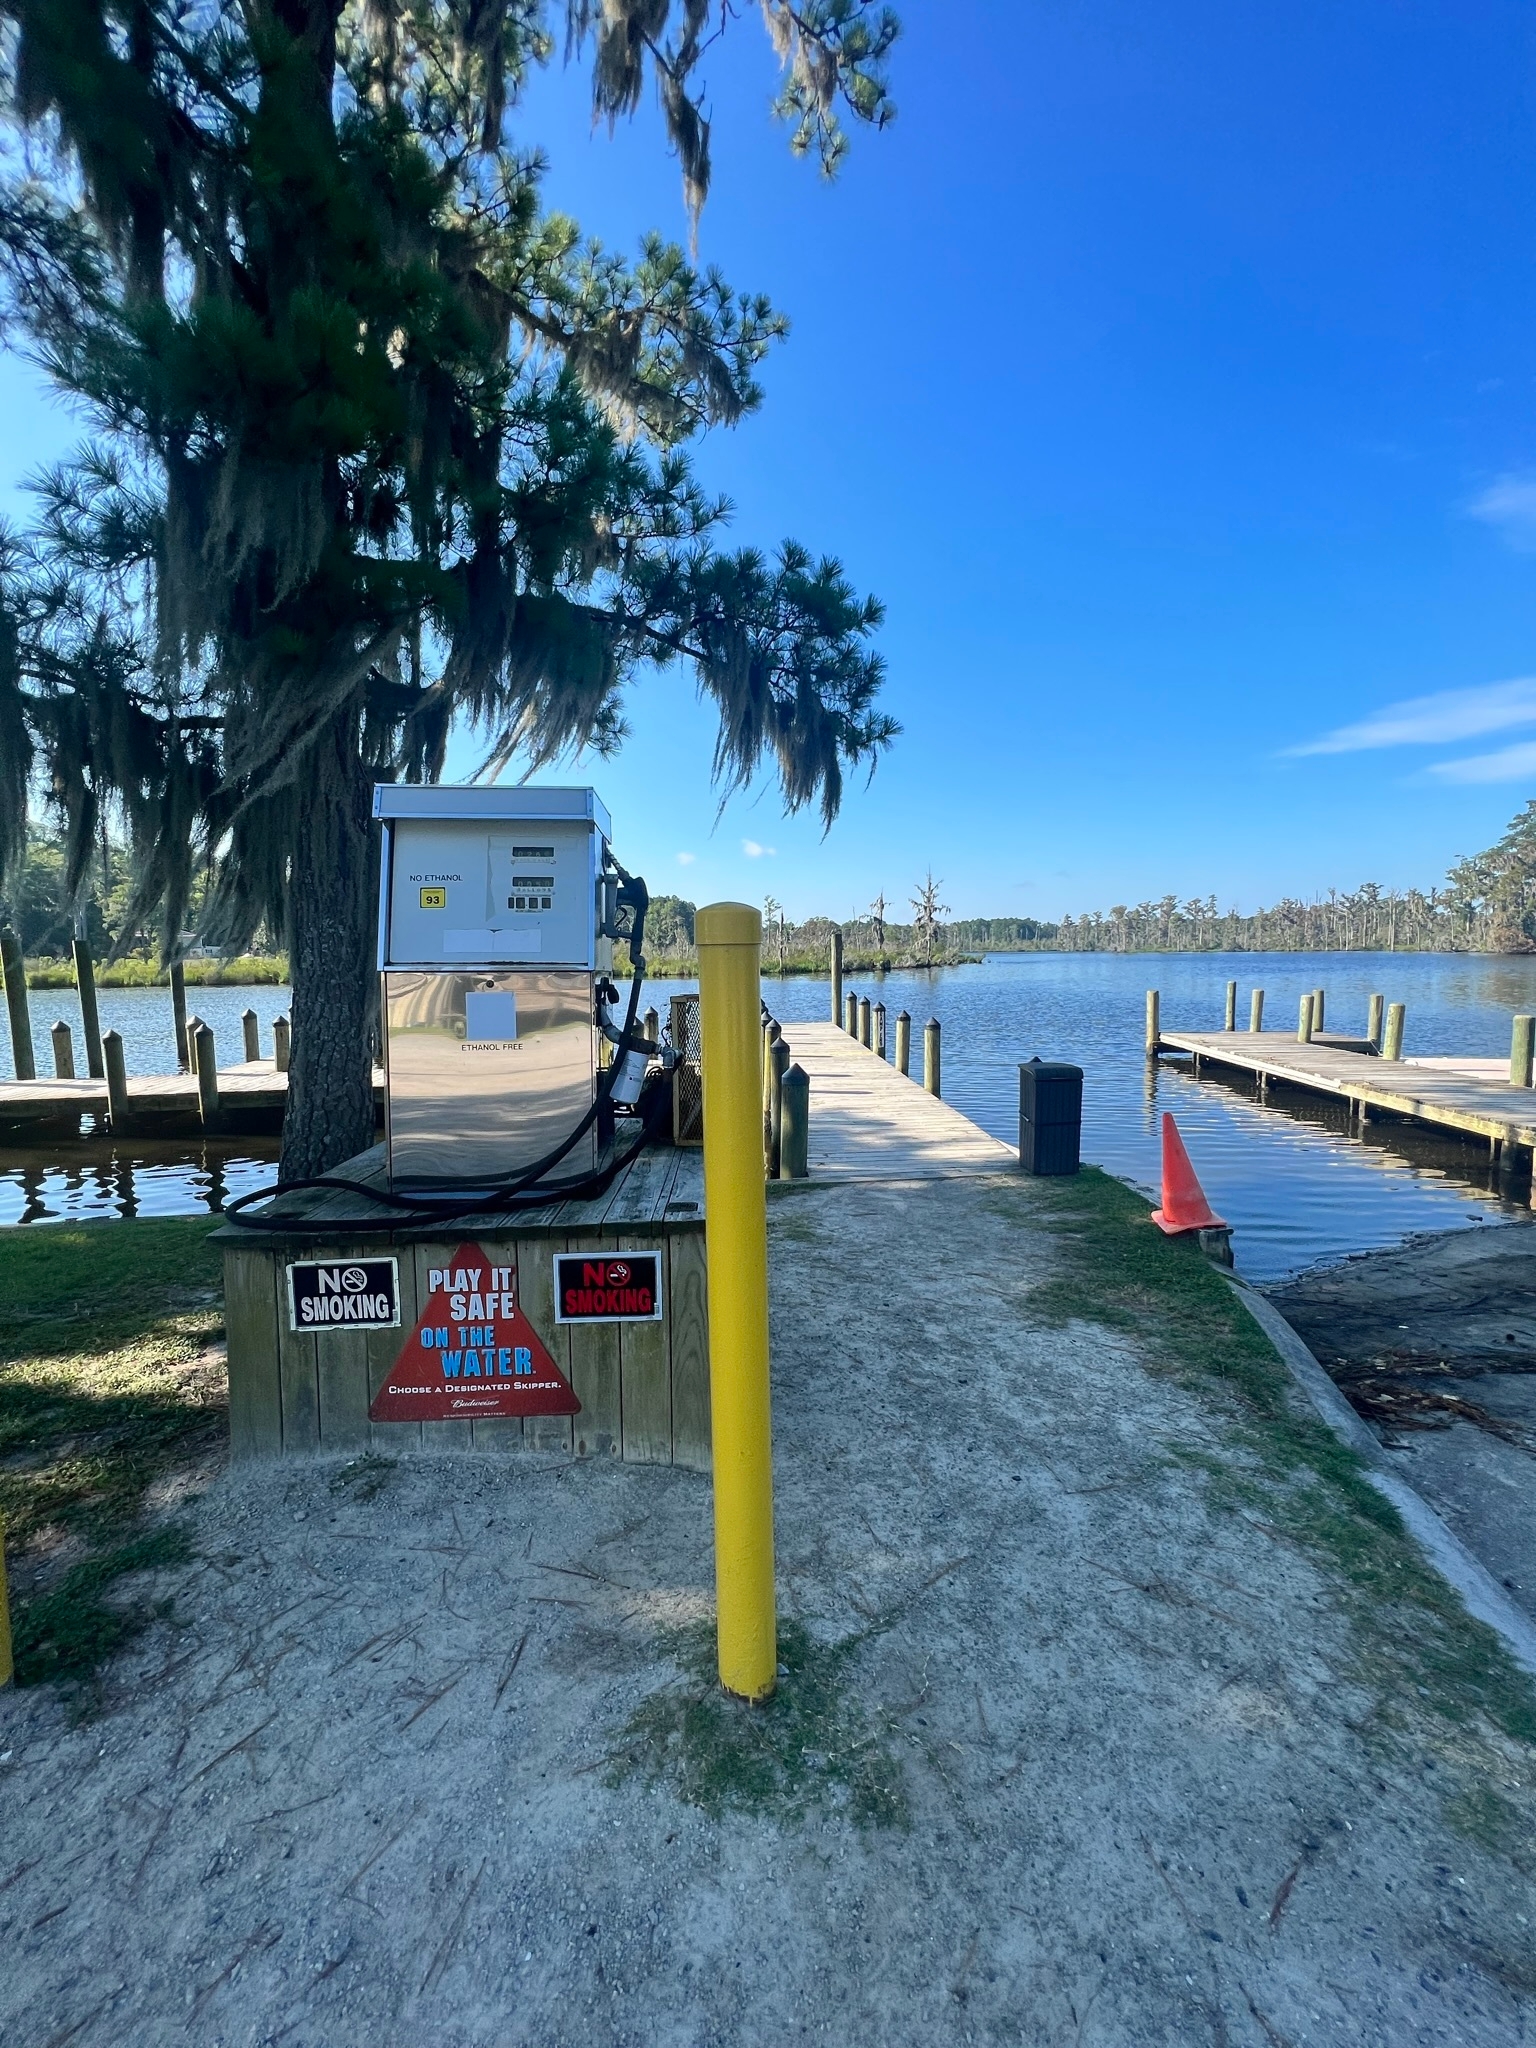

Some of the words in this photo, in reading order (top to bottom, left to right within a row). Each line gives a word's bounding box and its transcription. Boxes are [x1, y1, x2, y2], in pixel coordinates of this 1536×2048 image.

[424, 874, 463, 882] ETHANOL
[426, 895, 440, 905] 93
[461, 1043, 500, 1051] ETHANOL
[317, 1267, 368, 1293] NO
[429, 1268, 482, 1293] PLAY
[491, 1267, 512, 1291] IT
[583, 1261, 631, 1287] NO
[300, 1293, 390, 1322] SMOKING
[450, 1292, 515, 1321] SAFE
[565, 1287, 651, 1314] SMOKING
[420, 1326, 449, 1348] ON
[457, 1325, 495, 1347] THE
[441, 1347, 537, 1378] WATER.
[451, 1398, 500, 1409] Budweiser
